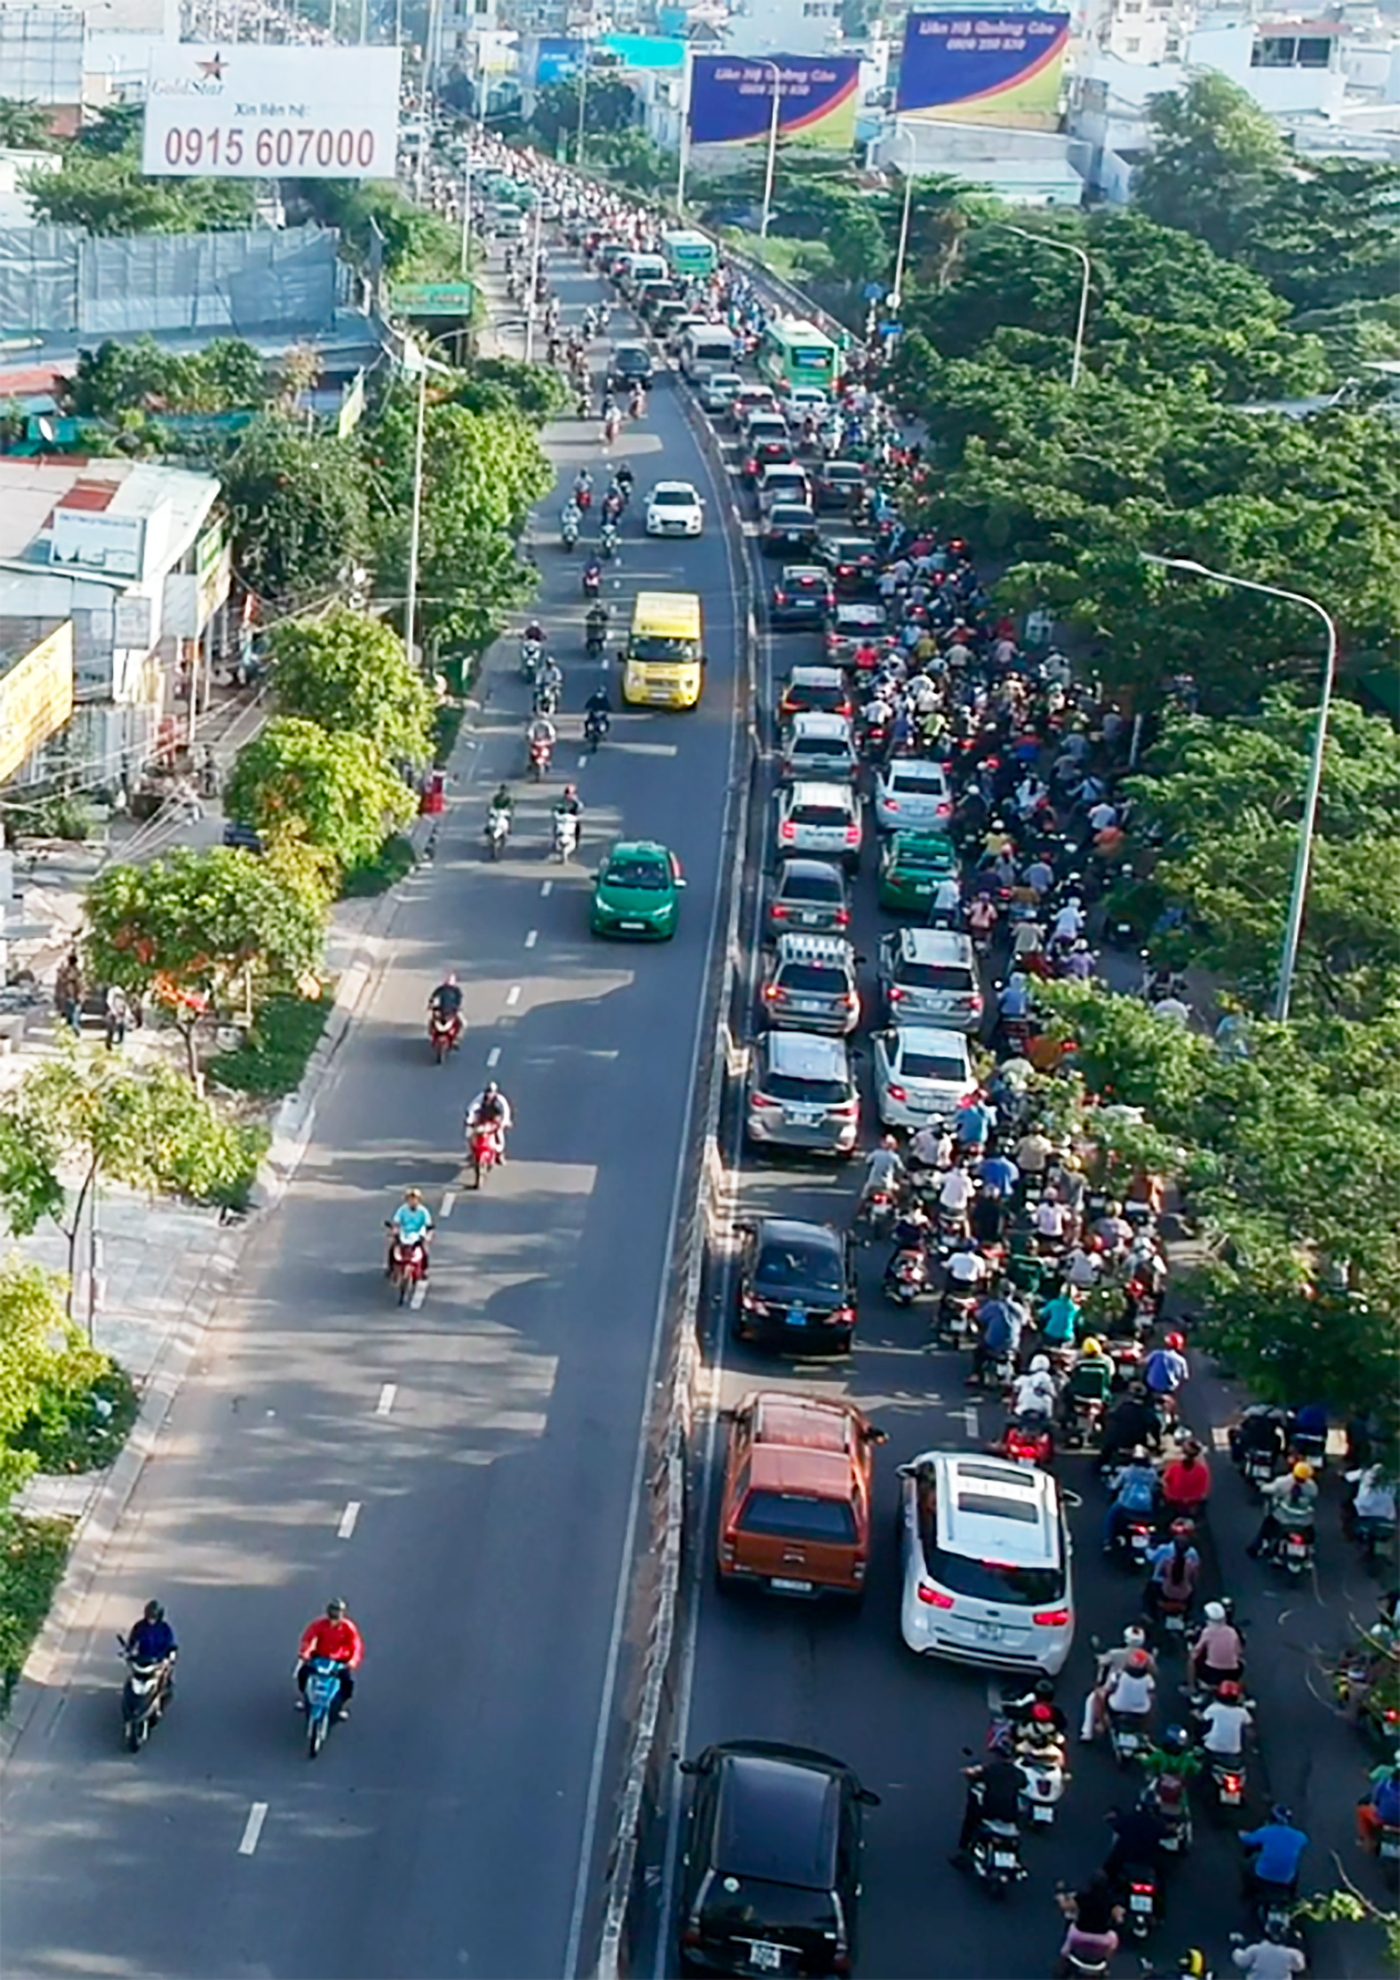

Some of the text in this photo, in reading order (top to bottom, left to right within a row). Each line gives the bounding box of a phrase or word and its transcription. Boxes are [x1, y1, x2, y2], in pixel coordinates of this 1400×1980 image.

[234, 103, 258, 117] Xin
[164, 126, 375, 167] 0915 607000
